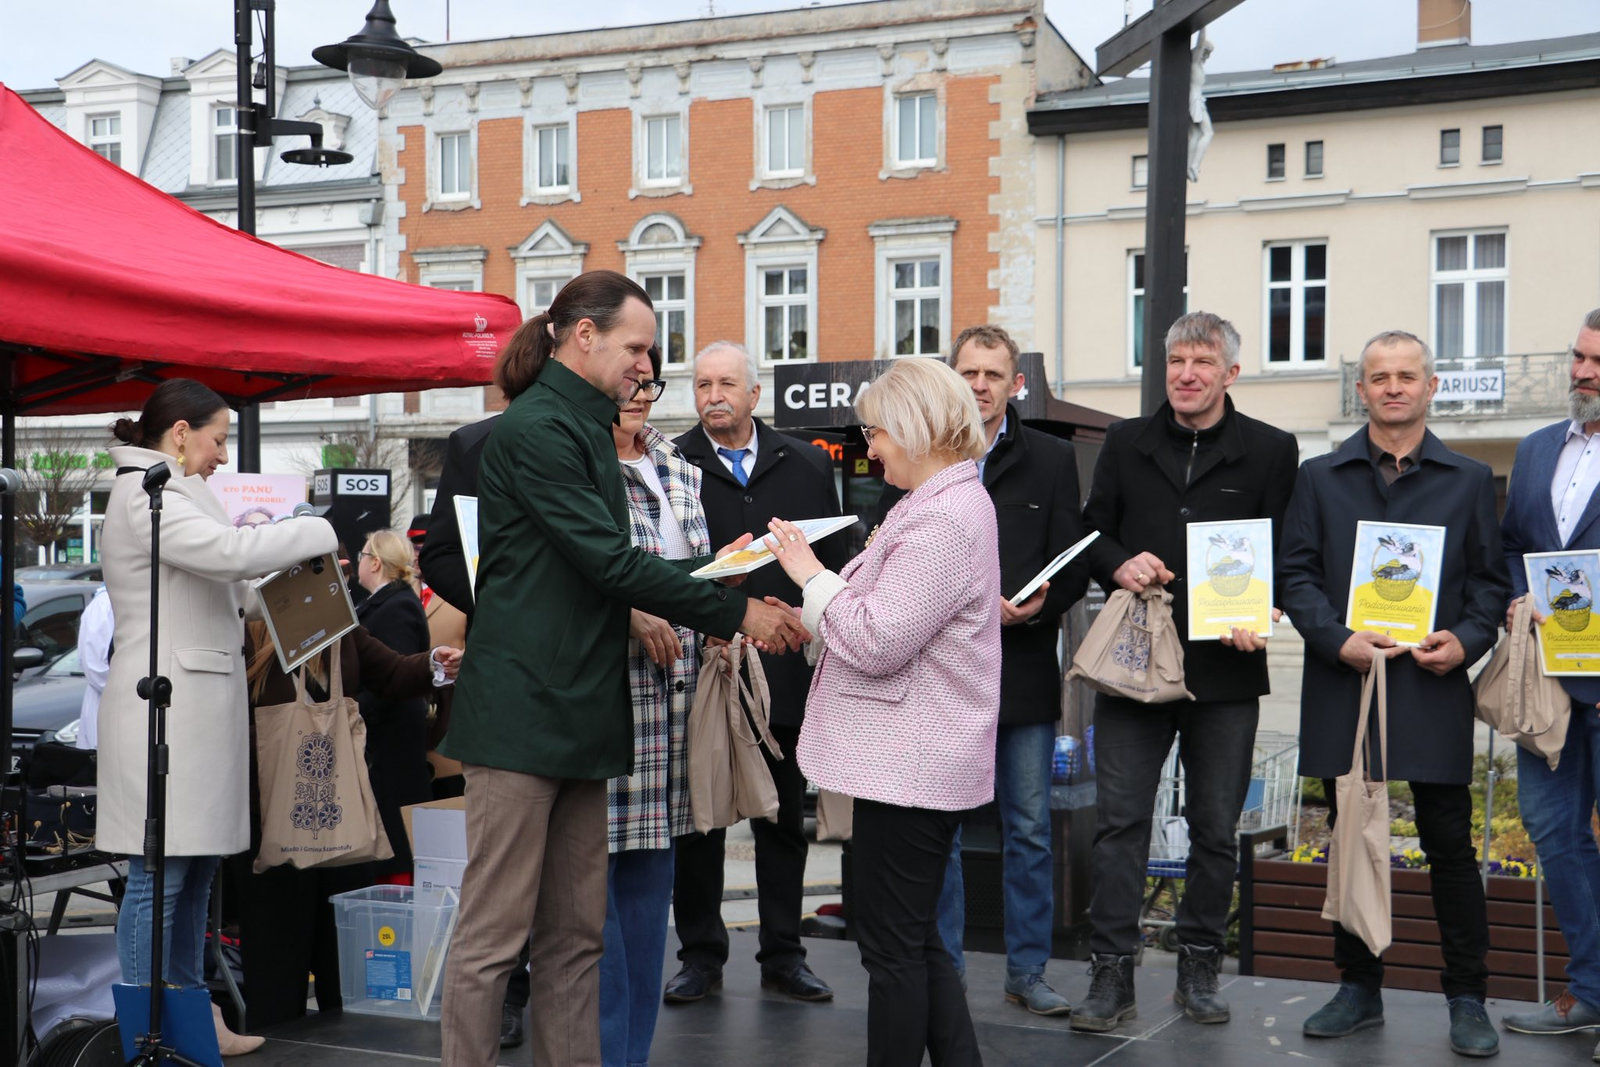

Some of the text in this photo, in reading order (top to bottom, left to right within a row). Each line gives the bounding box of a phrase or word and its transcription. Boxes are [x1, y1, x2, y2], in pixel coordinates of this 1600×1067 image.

[241, 485, 273, 494] PANU
[317, 478, 328, 492] SOS
[345, 478, 379, 492] SOS
